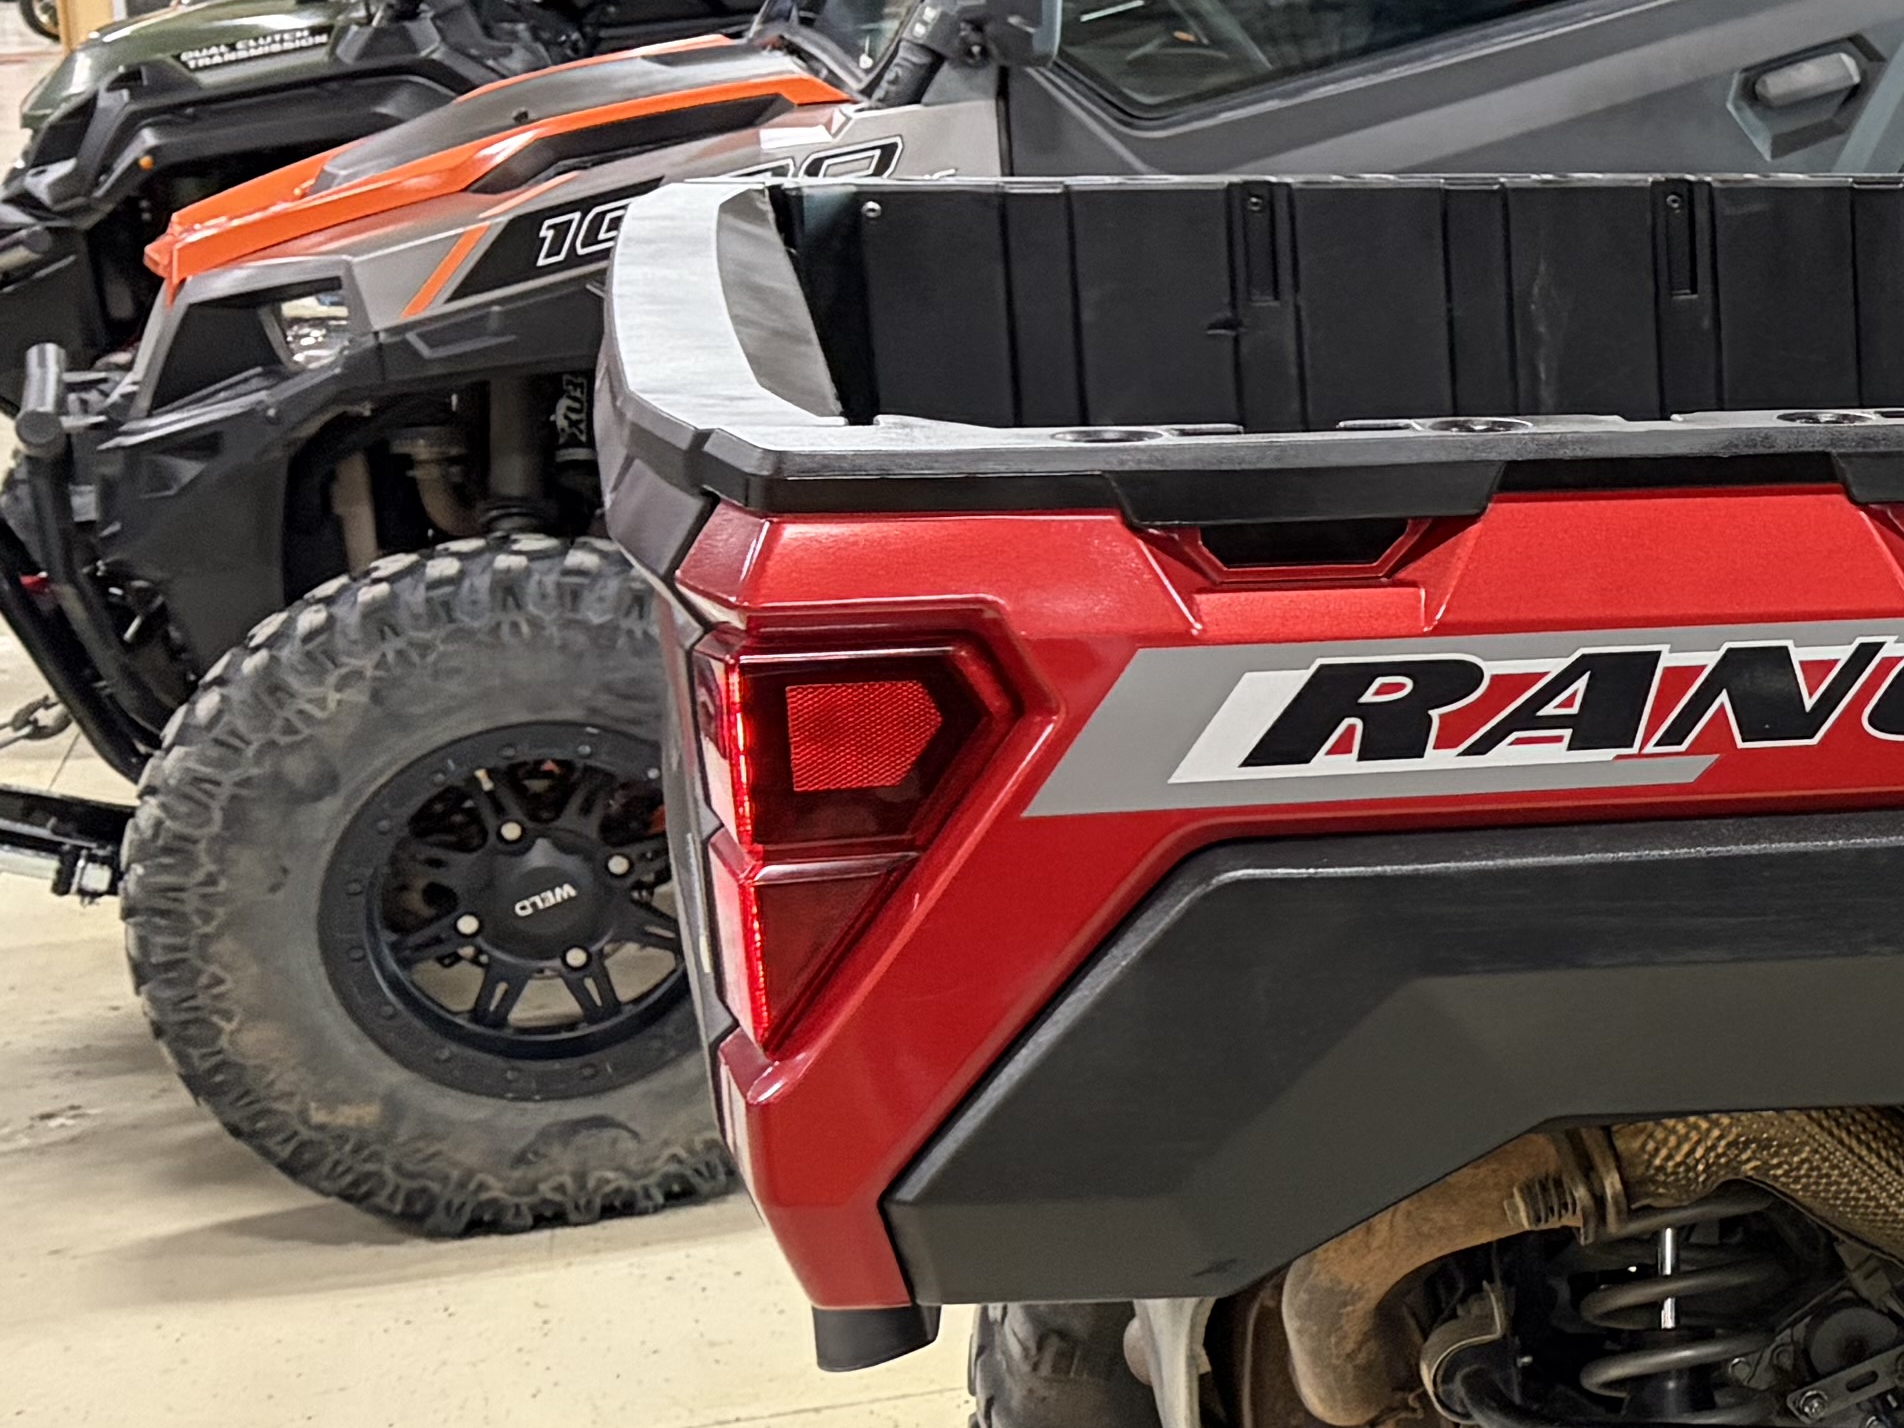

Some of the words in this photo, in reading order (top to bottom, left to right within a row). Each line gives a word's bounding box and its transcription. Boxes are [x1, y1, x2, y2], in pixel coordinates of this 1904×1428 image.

[181, 44, 229, 62] DUAL
[235, 30, 309, 50] CLUTCH
[187, 33, 328, 69] TRANSMISSION
[514, 882, 578, 917] WELD
